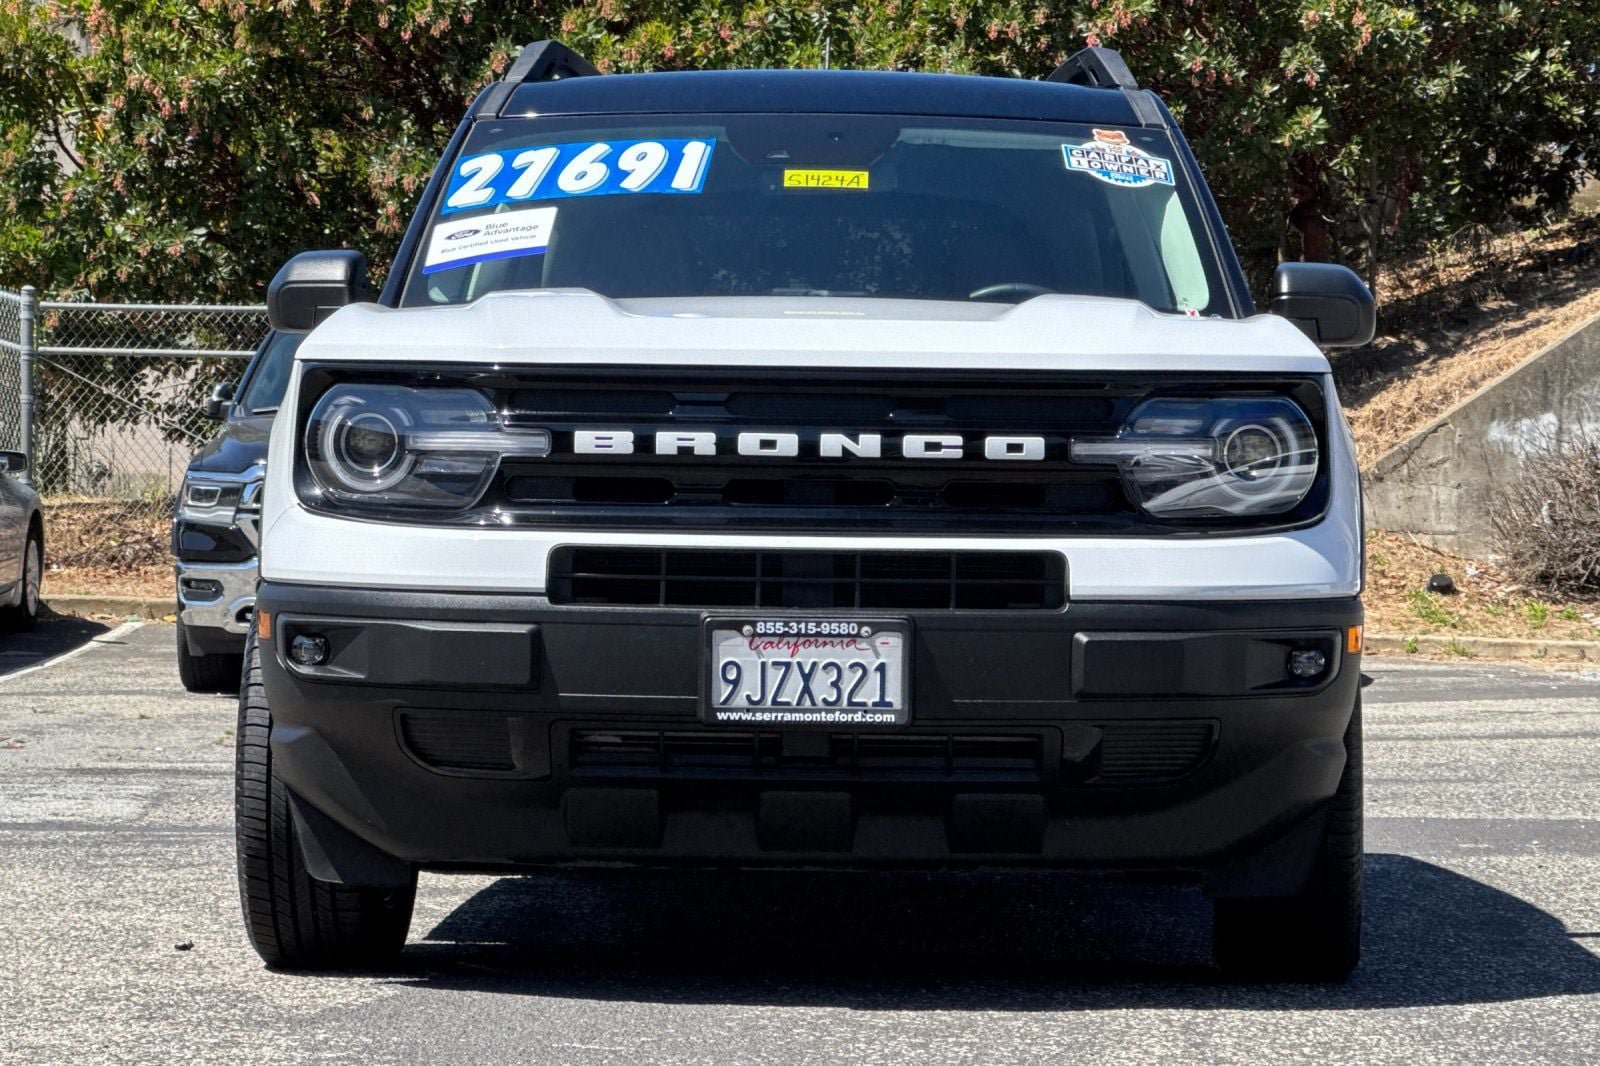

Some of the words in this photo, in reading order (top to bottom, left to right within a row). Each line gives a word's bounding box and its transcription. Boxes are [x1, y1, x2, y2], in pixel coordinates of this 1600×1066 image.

[1071, 149, 1165, 170] CARFAX
[447, 141, 711, 208] 27691
[1090, 161, 1166, 179] OWNER
[483, 225, 539, 236] Advantage
[485, 222, 508, 230] Blue
[458, 241, 489, 250] Certified
[573, 430, 1046, 460] BRONCO
[756, 622, 858, 635] 855-315-9580
[748, 636, 871, 657] California
[719, 660, 894, 708] 9JZX321
[716, 710, 895, 722] www.serramonteford.com
